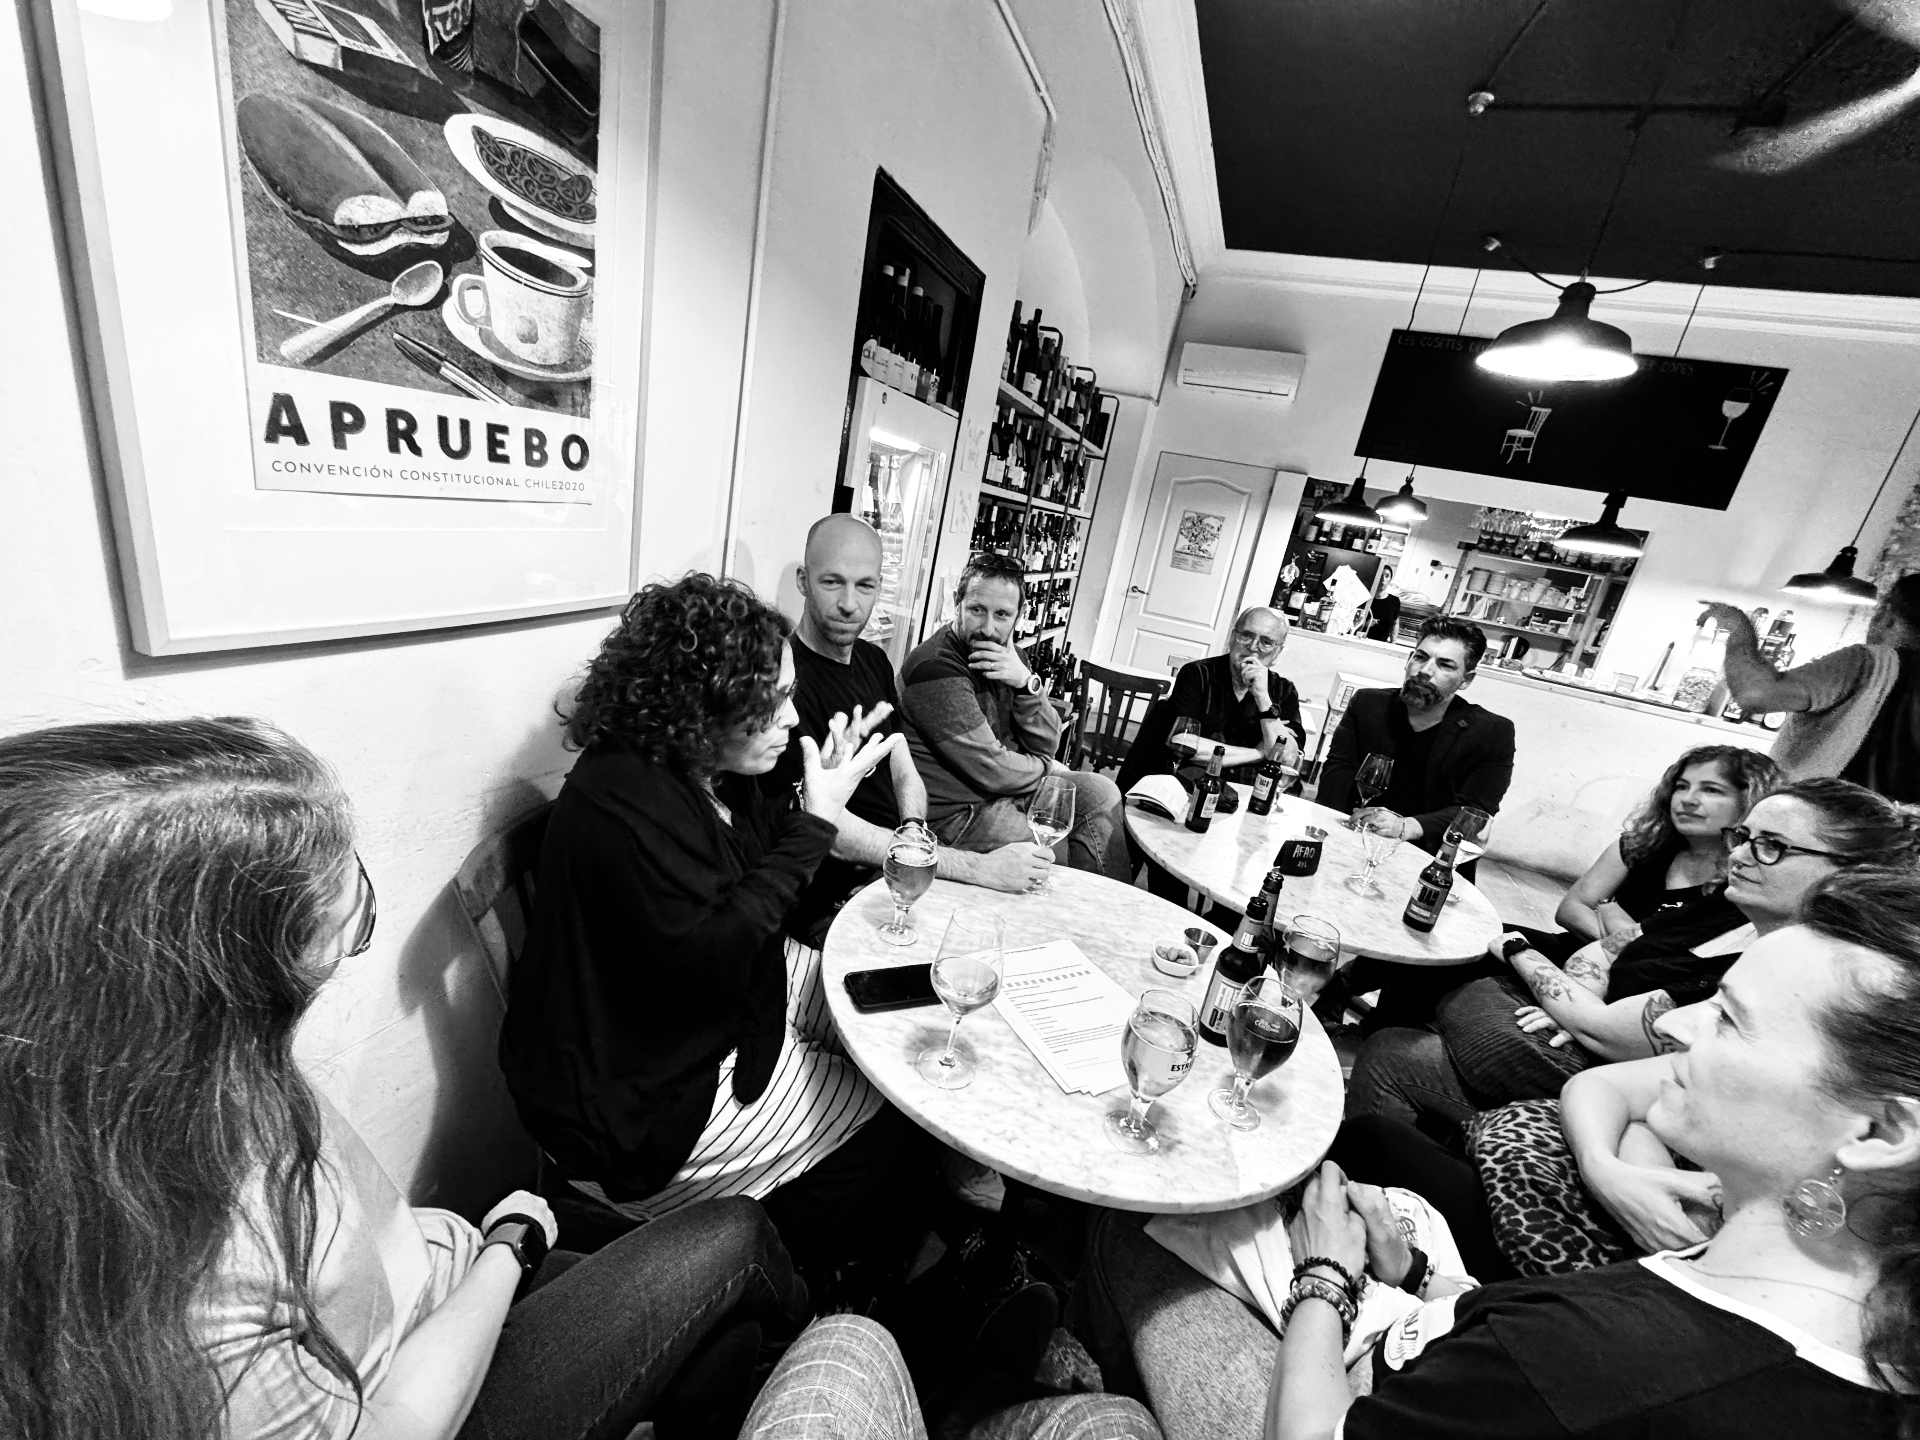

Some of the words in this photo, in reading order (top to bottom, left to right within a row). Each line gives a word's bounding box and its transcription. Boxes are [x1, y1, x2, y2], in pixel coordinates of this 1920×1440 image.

[264, 392, 590, 471] APRUEBO
[271, 460, 393, 479] CONVENCIÓN
[400, 469, 520, 488] CONSTITUCIONAL
[525, 479, 586, 492] CHILE2020
